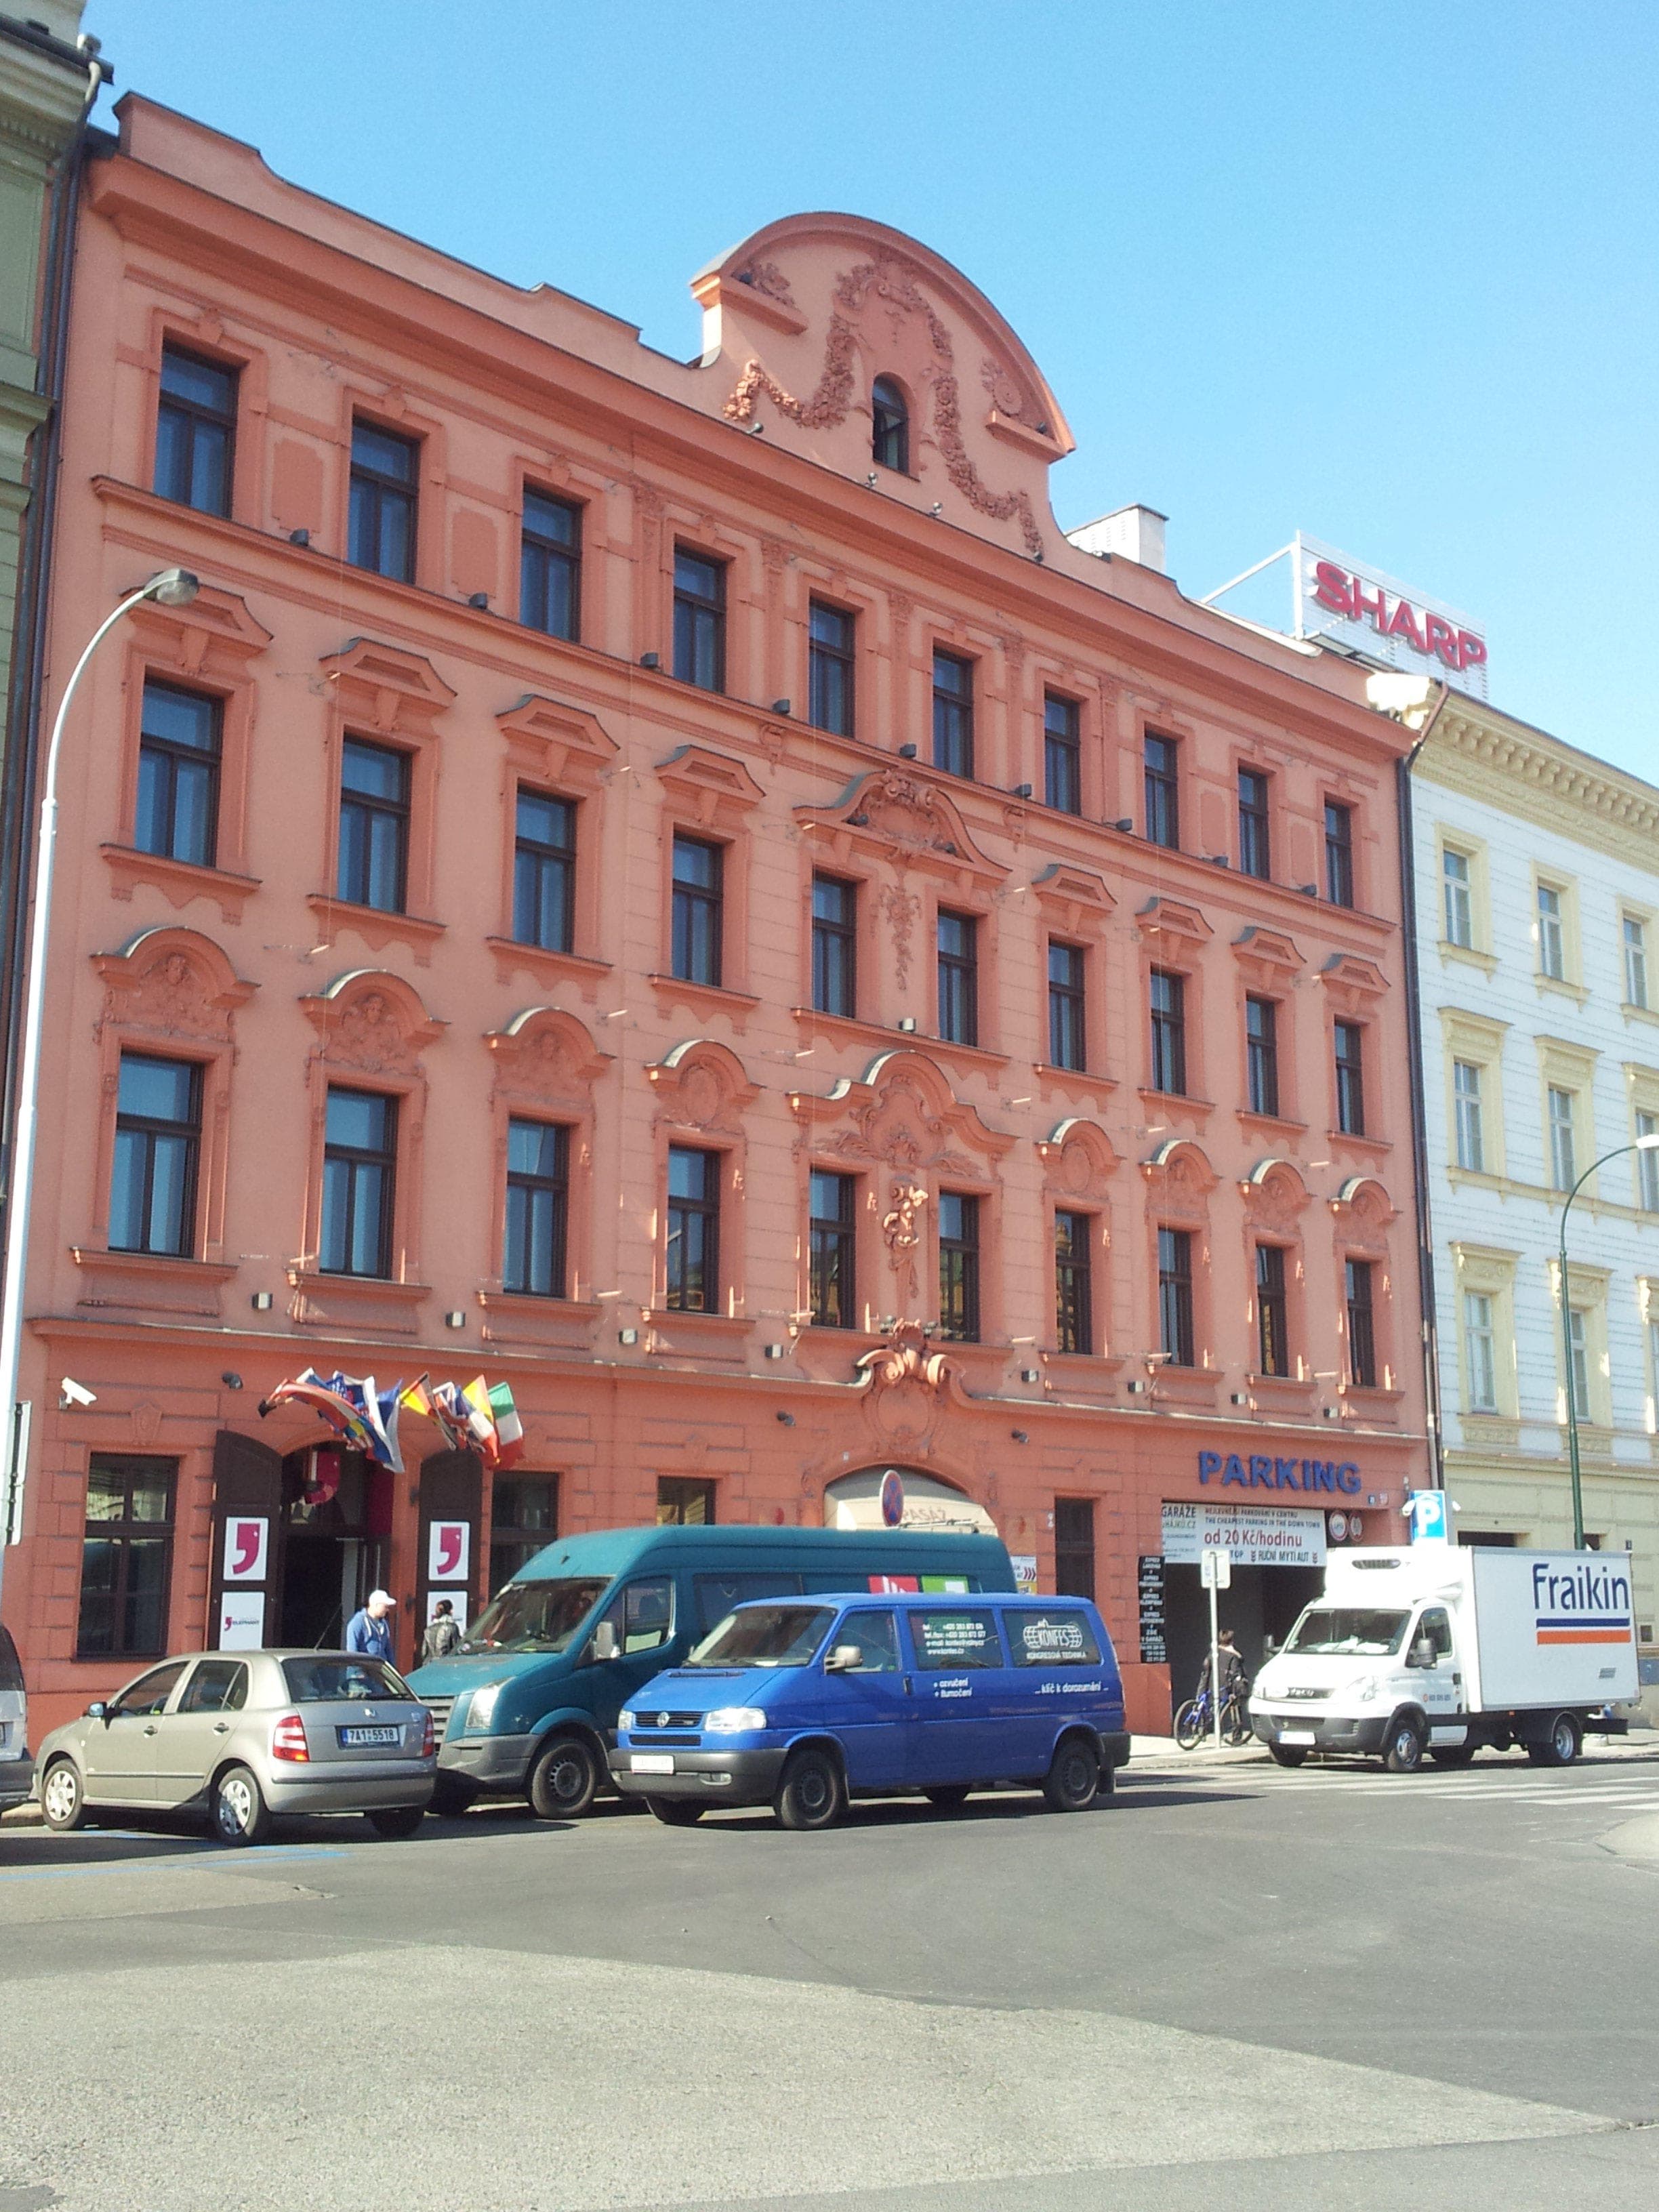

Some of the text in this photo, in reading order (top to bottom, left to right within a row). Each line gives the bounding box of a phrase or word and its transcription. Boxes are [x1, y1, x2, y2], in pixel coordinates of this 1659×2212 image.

[1313, 561, 1488, 671] SHARP
[1199, 1451, 1362, 1494] PARKING
[1216, 1517, 1244, 1525] CHEAPEST
[1204, 1529, 1303, 1547] od 20 Kč/hodinu
[1533, 1563, 1629, 1610] Fraikin
[349, 1729, 394, 1742] 7A1 5518
